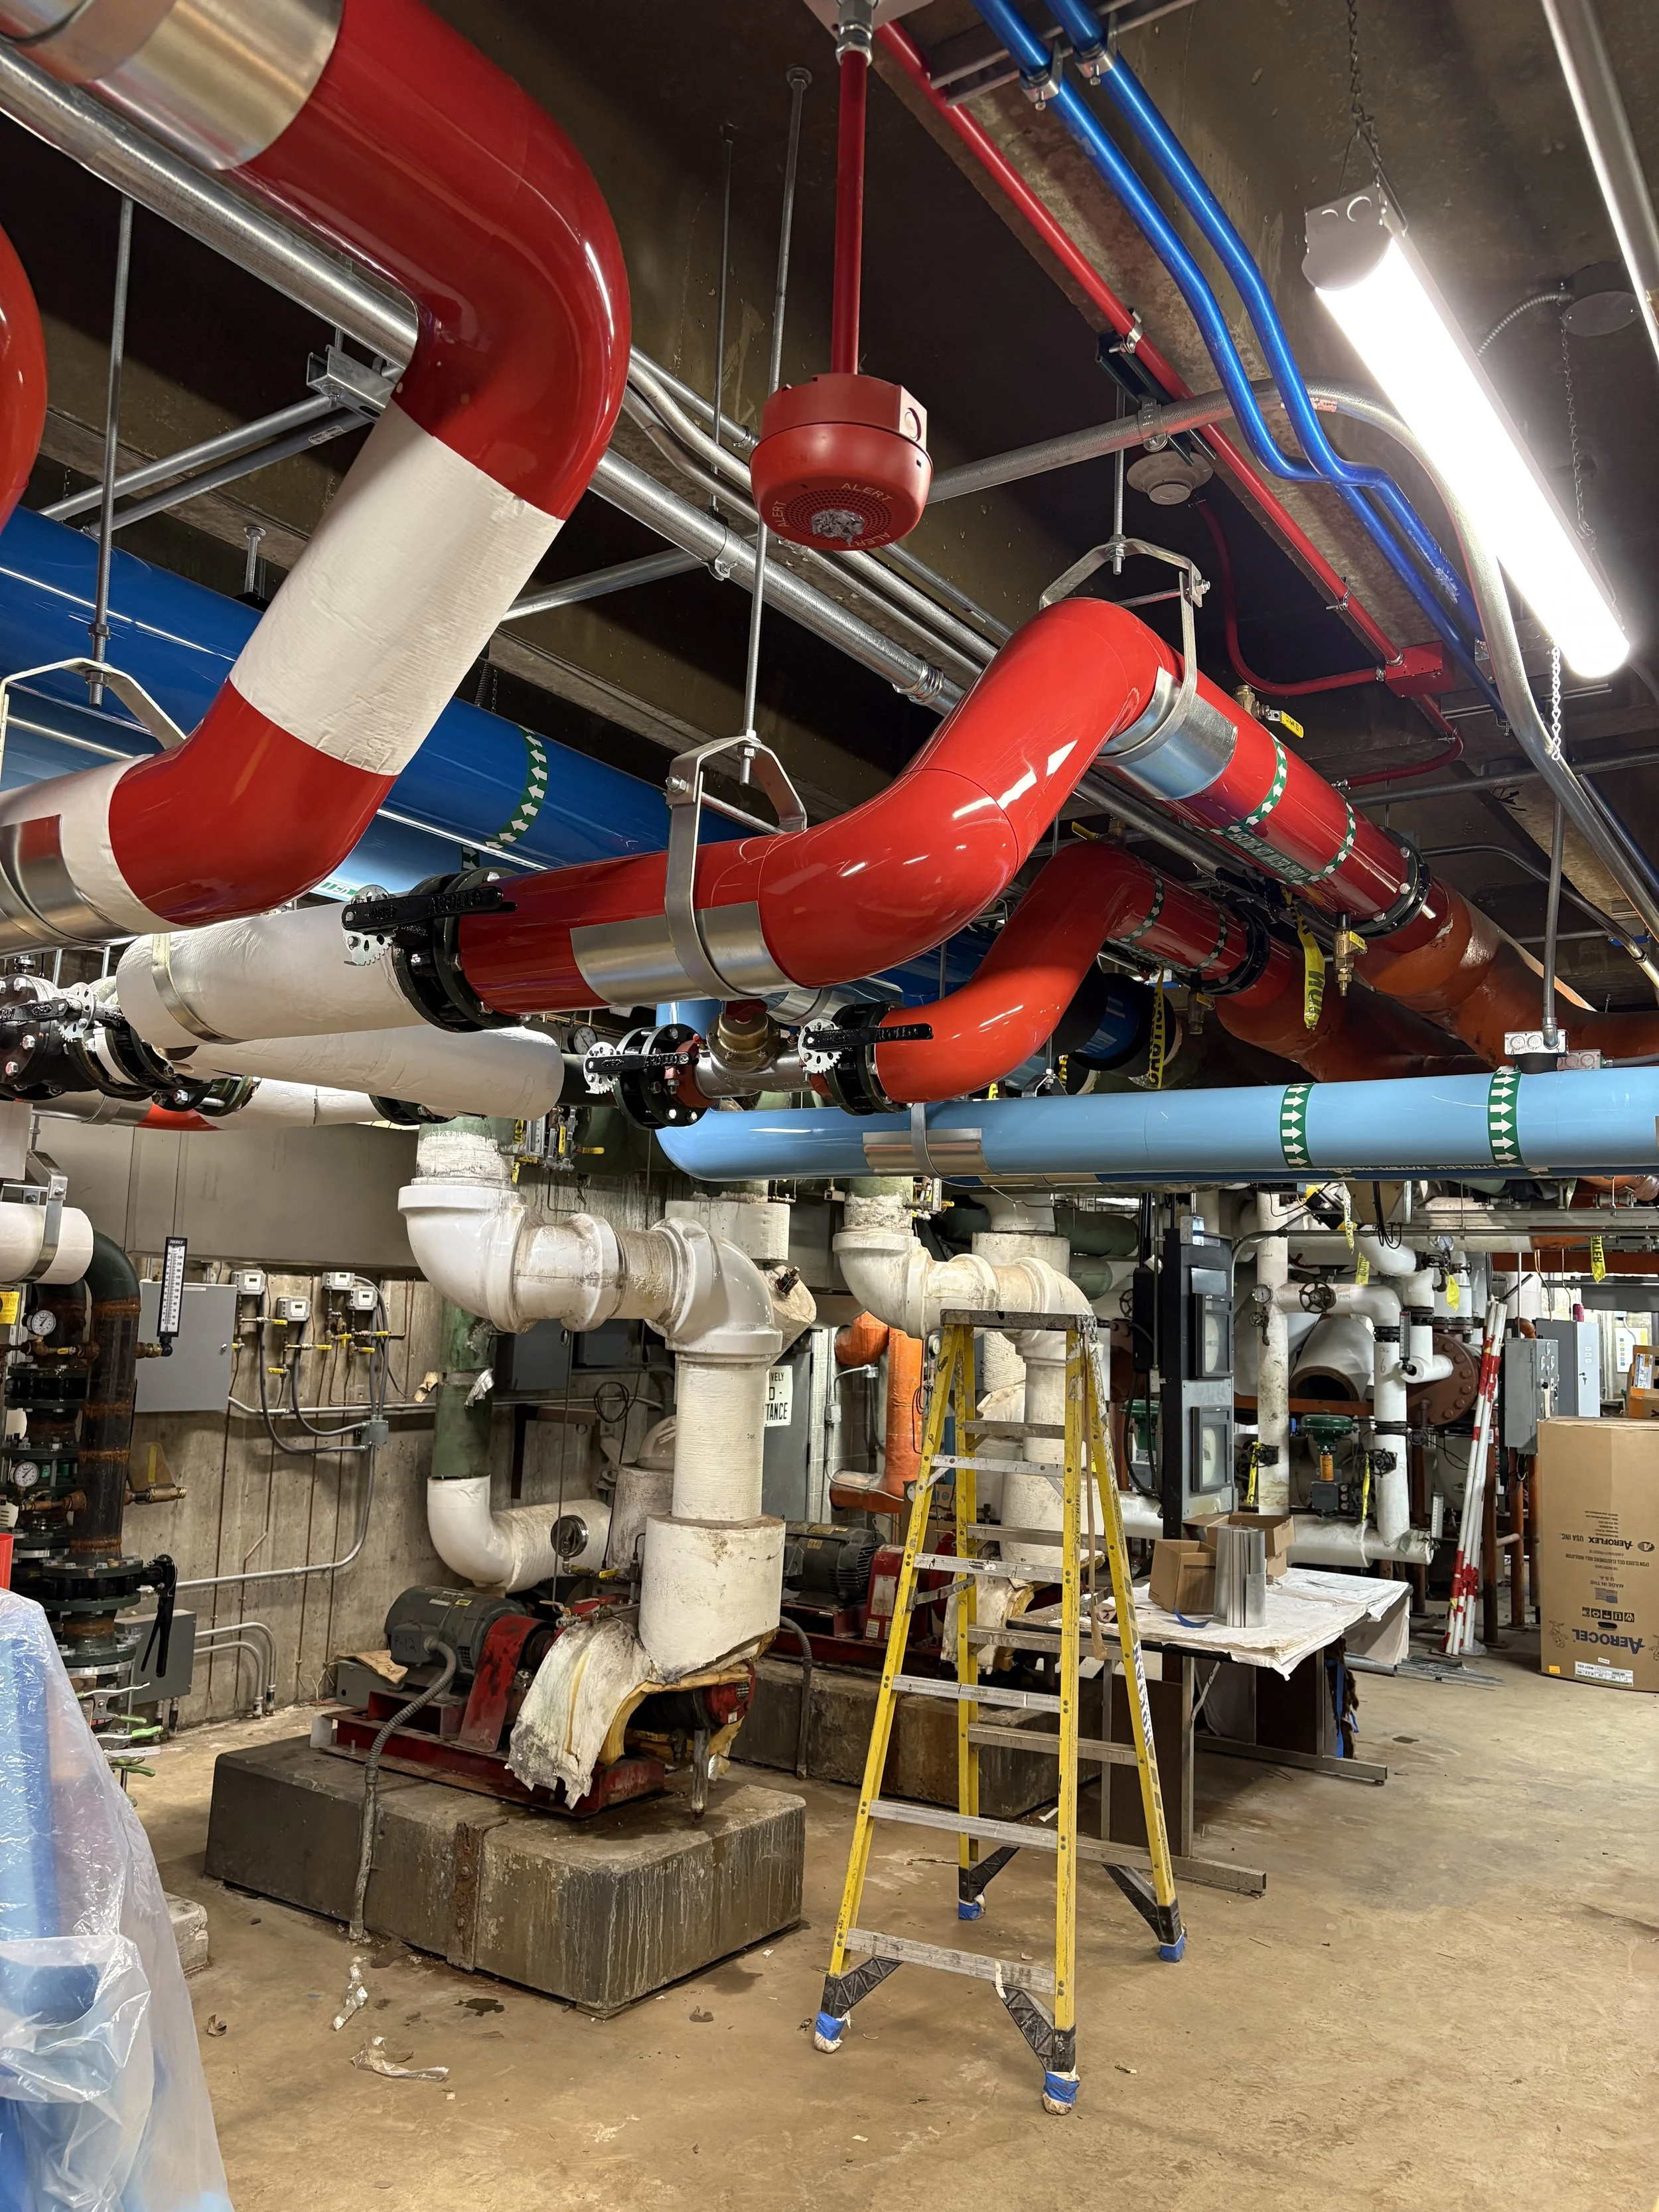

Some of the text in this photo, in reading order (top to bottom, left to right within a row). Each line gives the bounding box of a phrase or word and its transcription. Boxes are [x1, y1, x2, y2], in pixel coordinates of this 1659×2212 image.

[841, 482, 893, 501] ALERT
[772, 500, 789, 527] ALERT
[846, 532, 891, 548] ALERT
[1588, 1536, 1633, 1550] AEROFLEX
